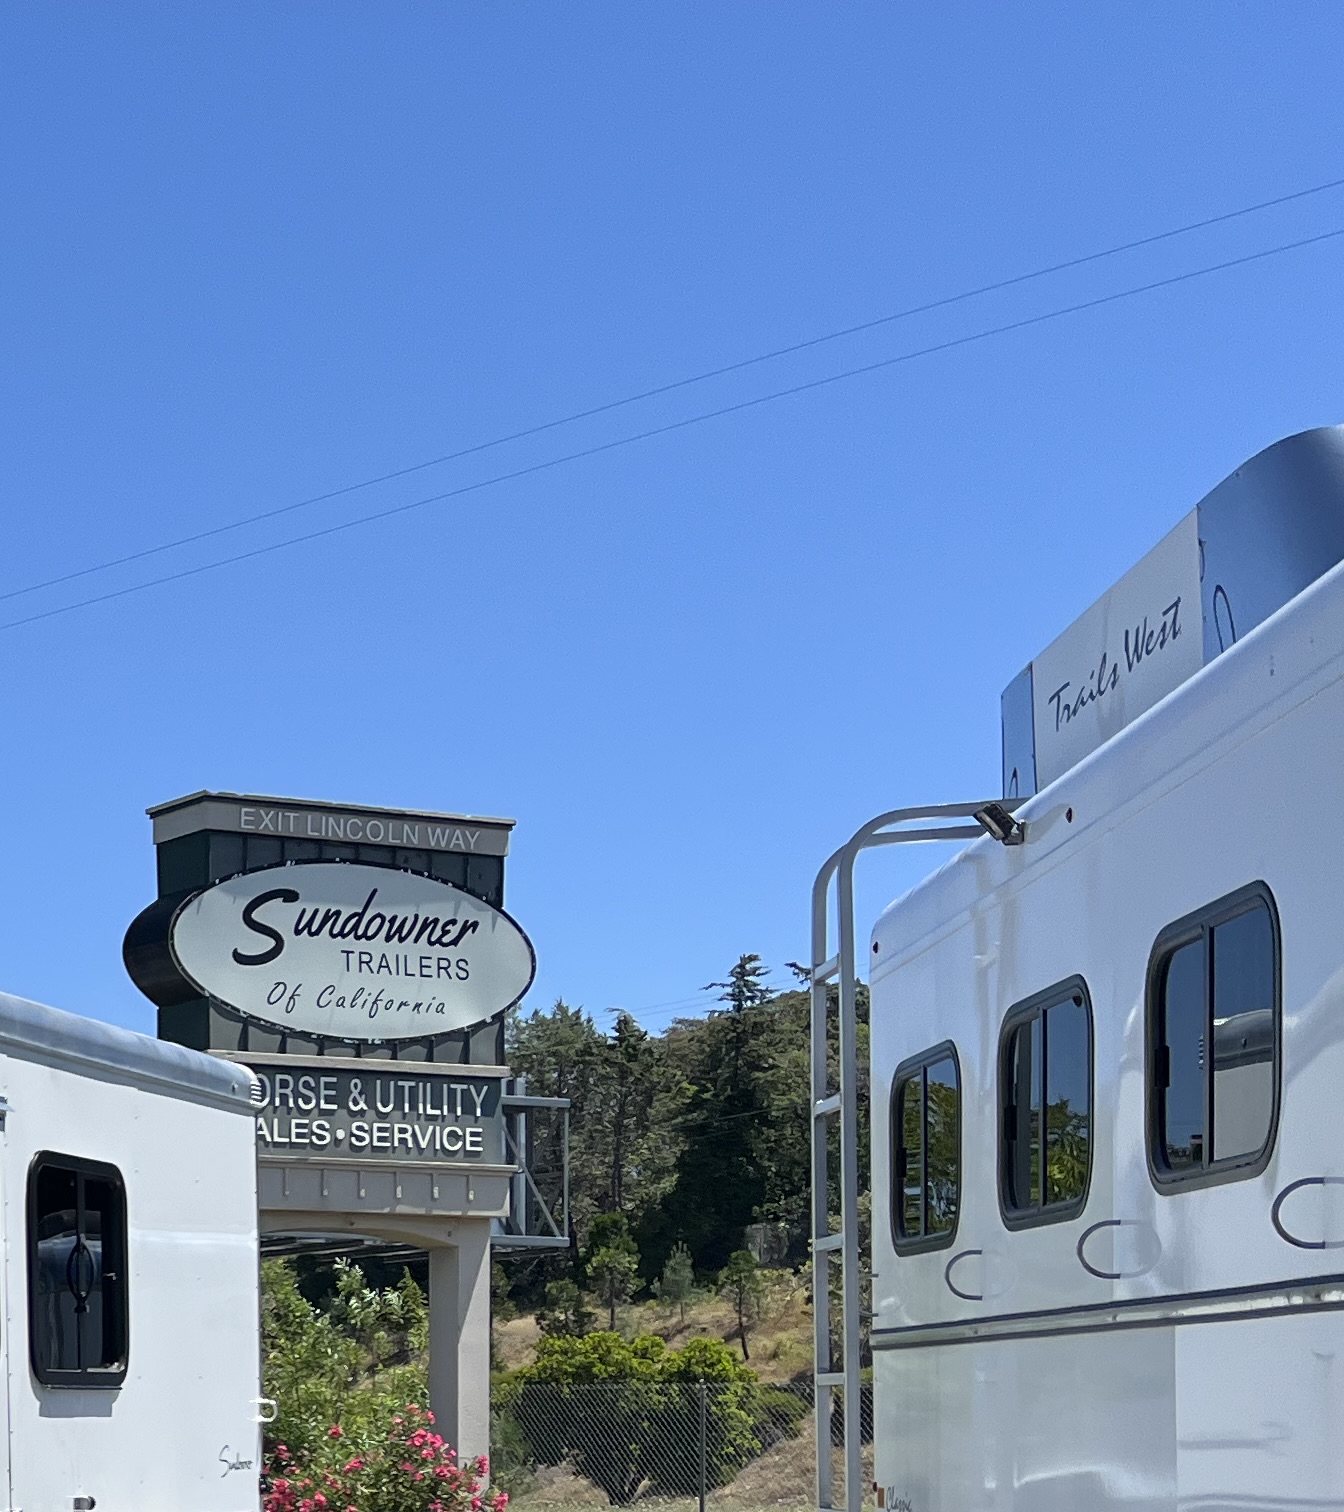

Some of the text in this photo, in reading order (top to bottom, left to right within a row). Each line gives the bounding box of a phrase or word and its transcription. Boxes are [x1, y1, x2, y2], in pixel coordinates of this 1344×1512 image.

[1048, 596, 1182, 732] Trails West
[240, 807, 480, 850] EXIT LINCOLN WAY
[232, 888, 480, 966] Sundowner
[340, 949, 470, 981] TRAILERS
[266, 981, 446, 1019] Of California
[256, 1073, 489, 1117] ORSE & UTILITY
[257, 1117, 484, 1152] ALES SERVICE
